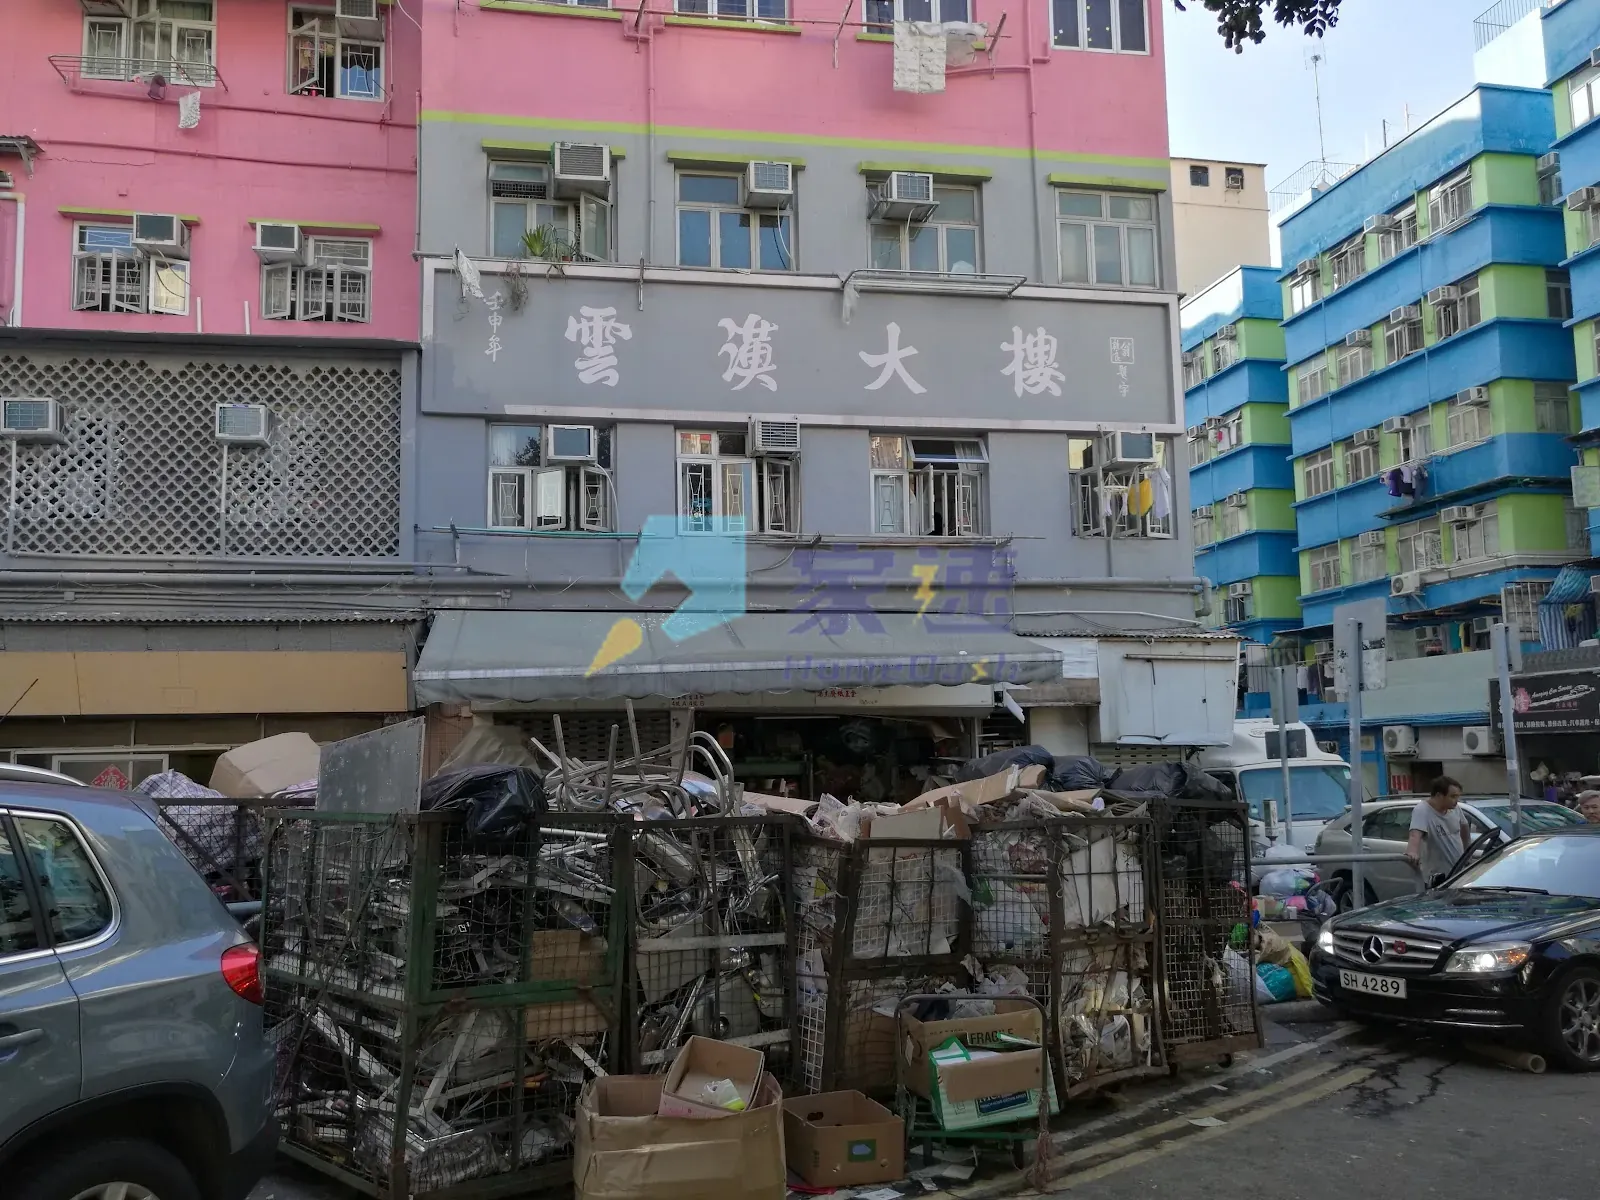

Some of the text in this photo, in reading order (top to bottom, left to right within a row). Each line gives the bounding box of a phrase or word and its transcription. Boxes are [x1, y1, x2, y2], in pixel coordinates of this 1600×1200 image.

[564, 305, 1066, 398] 雲漢大樓
[1343, 972, 1400, 995] SH 4289
